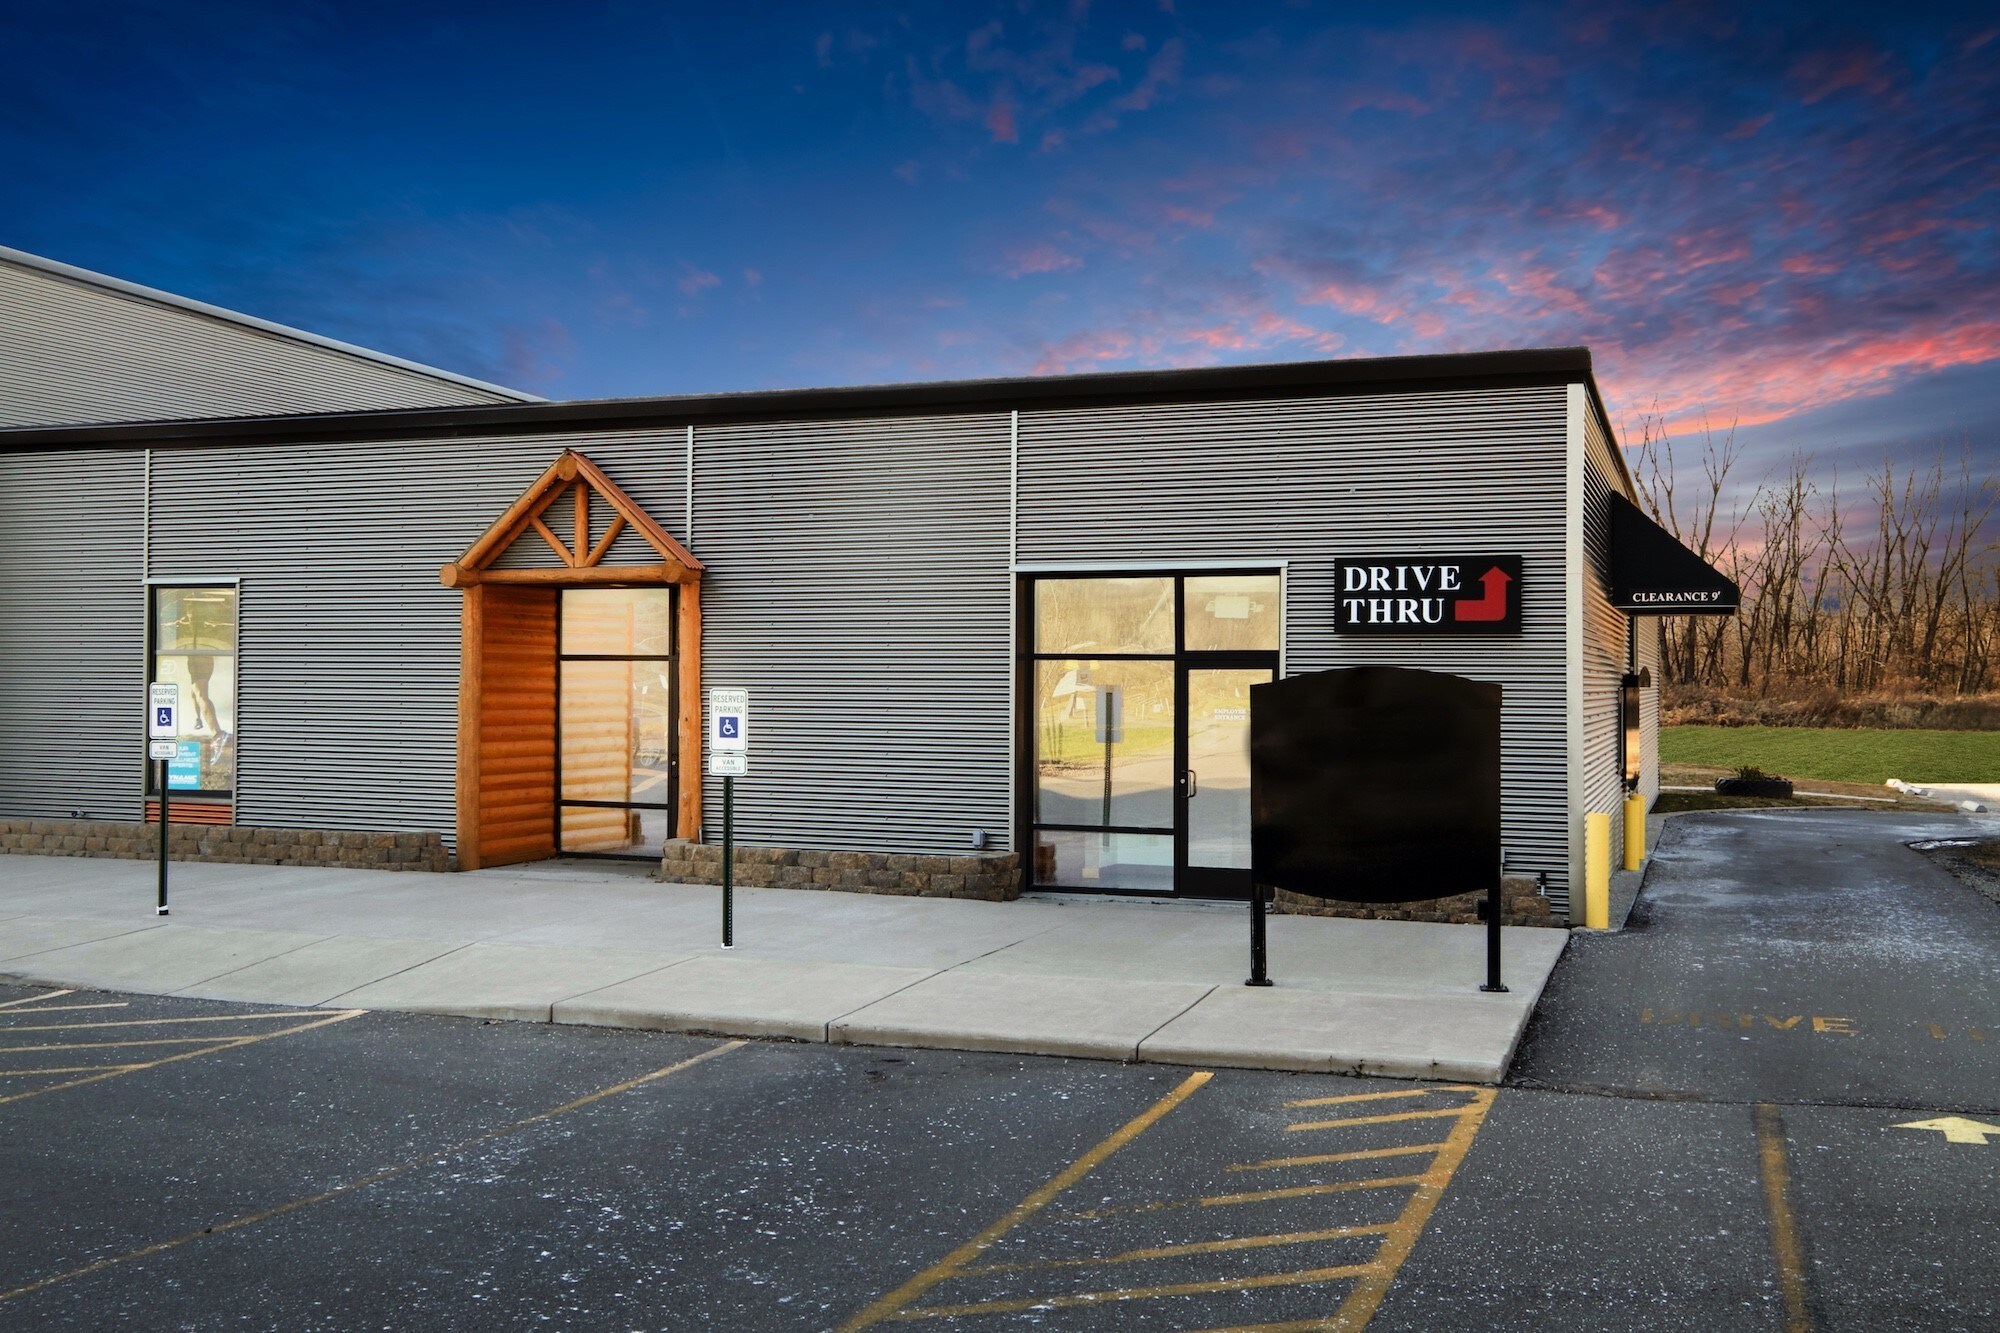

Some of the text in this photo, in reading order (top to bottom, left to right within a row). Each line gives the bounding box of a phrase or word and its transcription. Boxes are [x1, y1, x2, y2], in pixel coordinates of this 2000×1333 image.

[1343, 565, 1461, 592] DRIVE
[1632, 590, 1721, 603] CLEARANCE 9'
[1343, 598, 1445, 624] THRU
[152, 688, 177, 696] RESERVED
[153, 697, 176, 705] PARKING
[713, 694, 745, 703] RESERVED
[714, 705, 743, 714] PARKING
